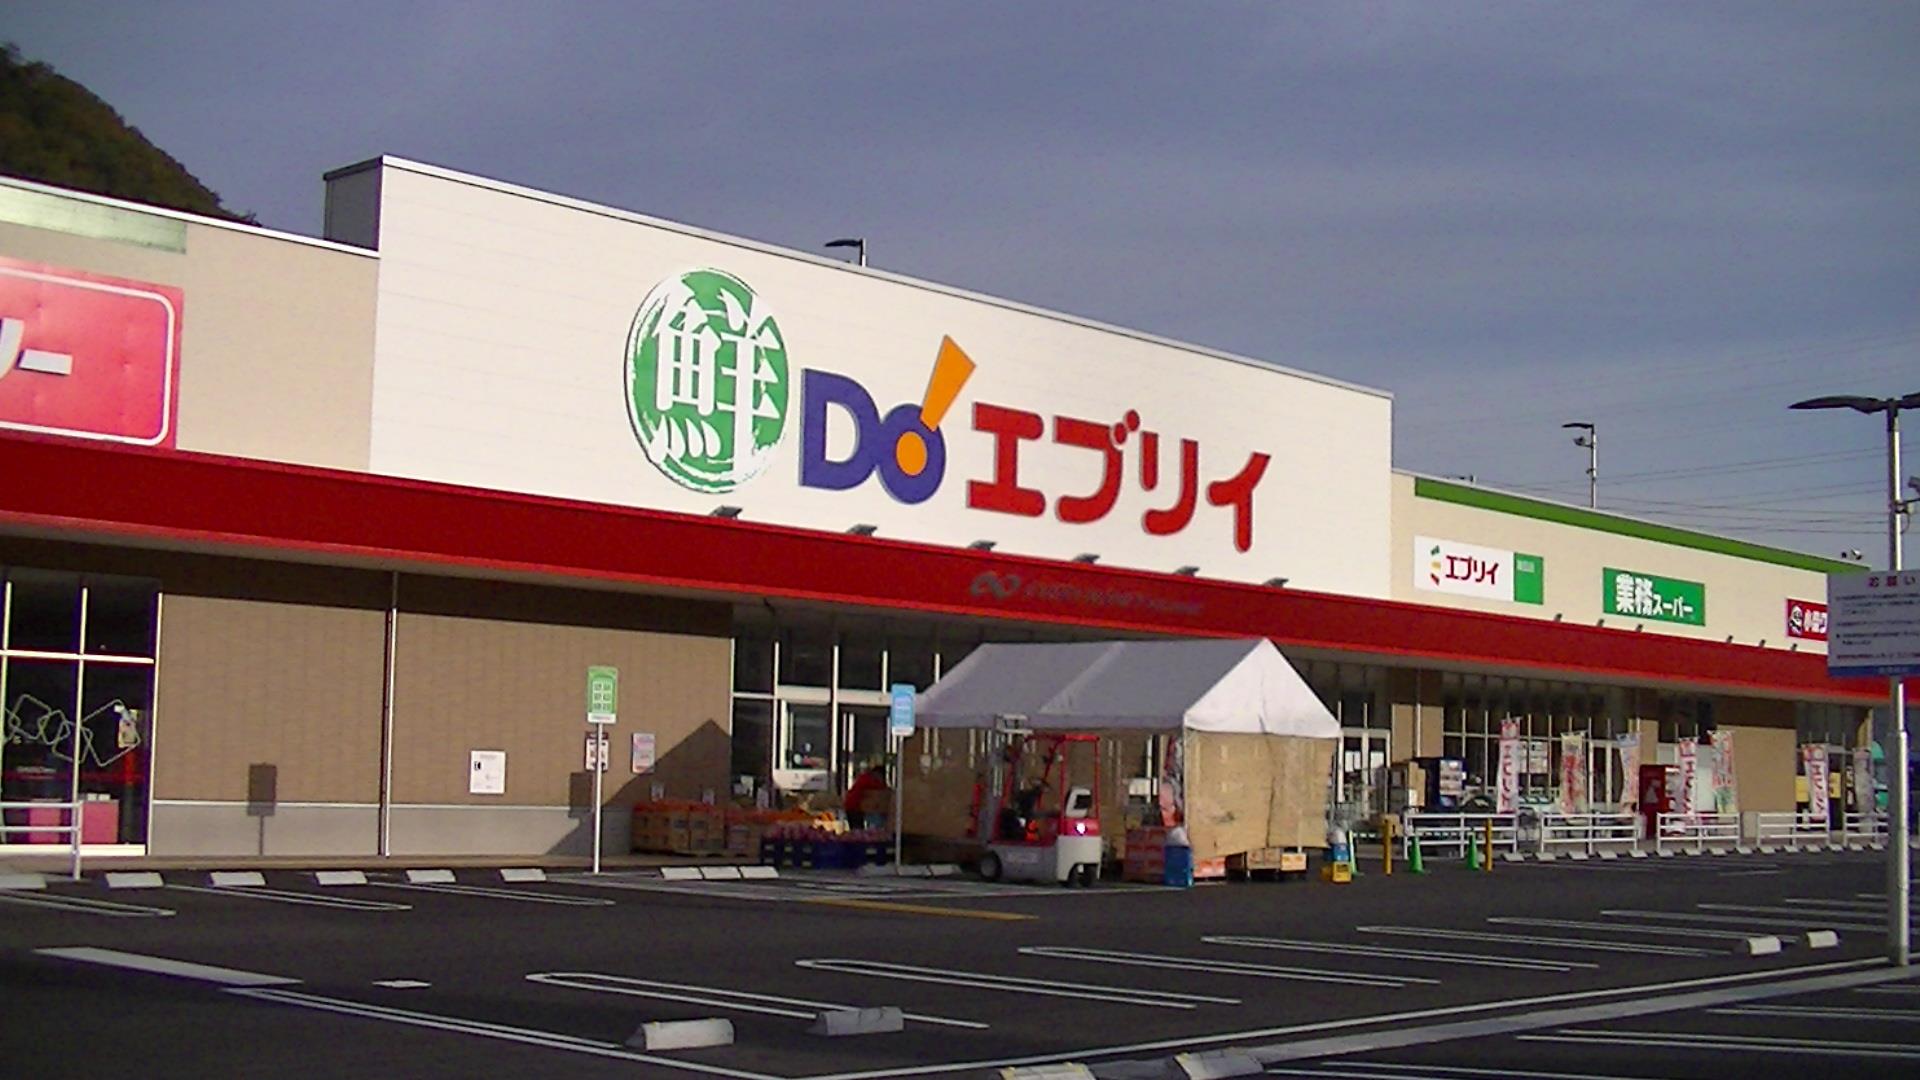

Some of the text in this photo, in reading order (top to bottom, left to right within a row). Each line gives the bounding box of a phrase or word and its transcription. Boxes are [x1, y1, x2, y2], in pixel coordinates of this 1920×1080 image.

[1616, 573, 1693, 618] 業務スーパー
